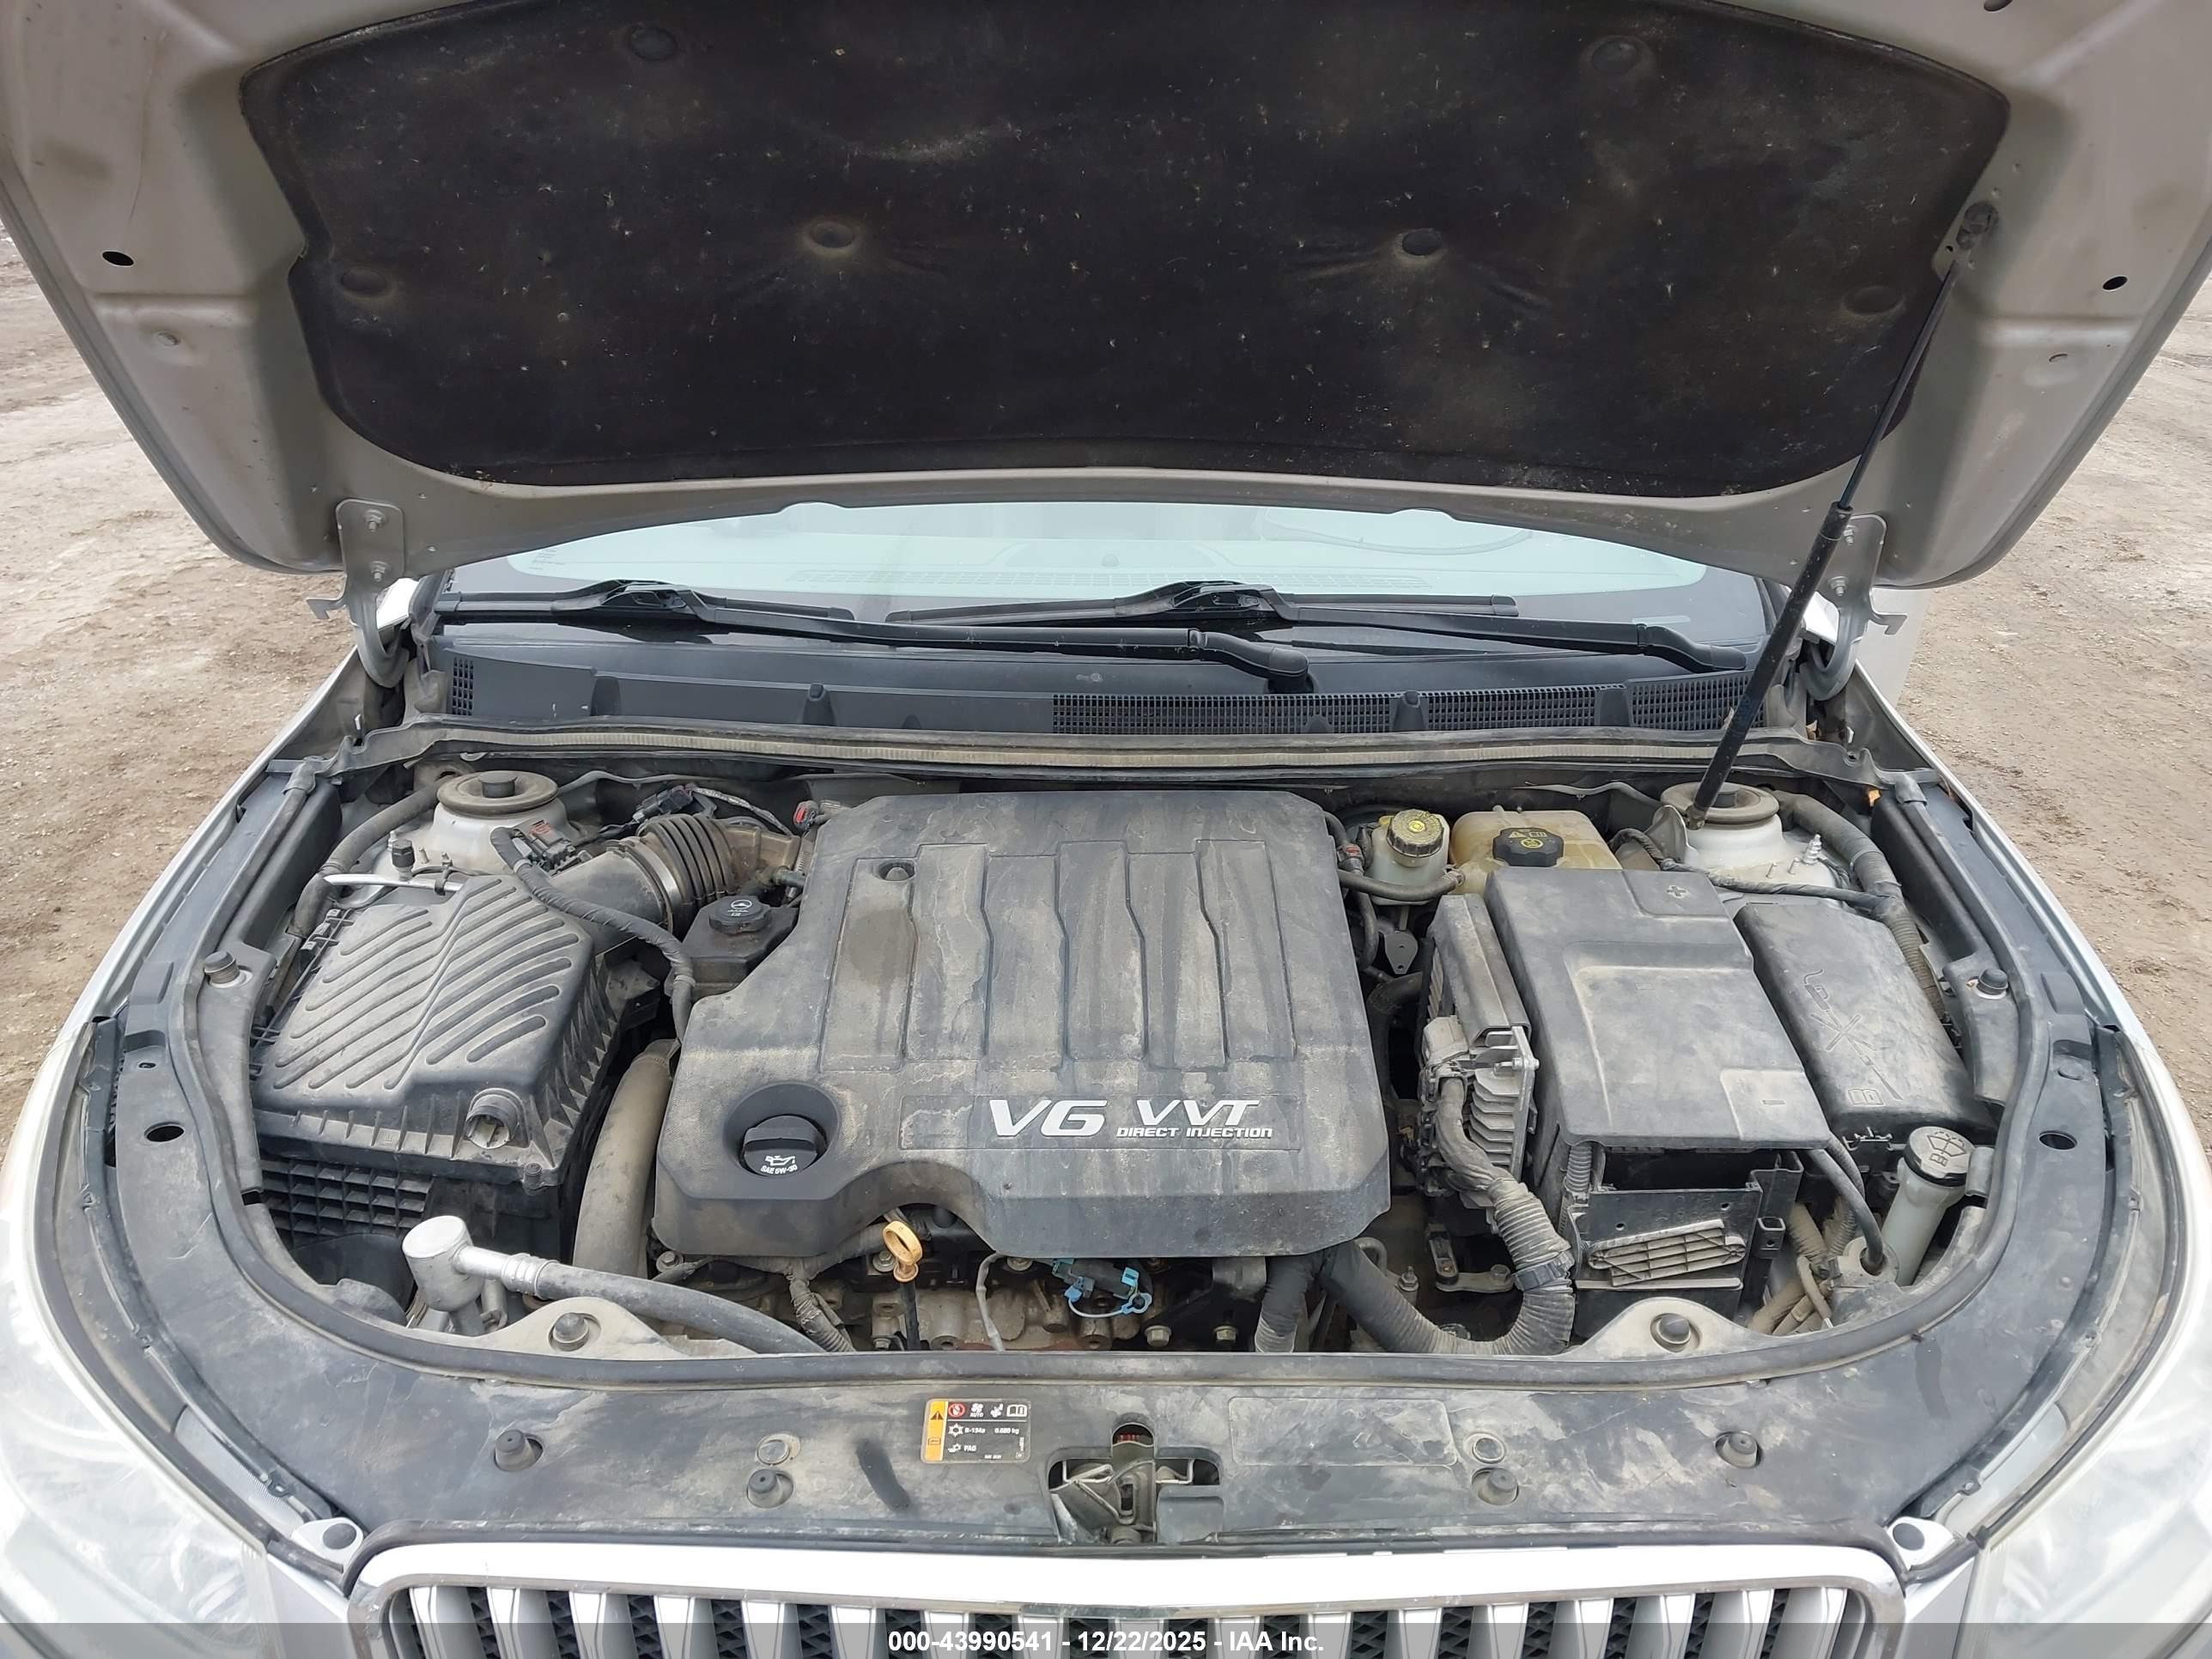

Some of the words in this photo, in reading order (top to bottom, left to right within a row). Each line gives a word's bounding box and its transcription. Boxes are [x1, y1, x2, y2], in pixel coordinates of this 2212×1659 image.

[989, 1099, 1108, 1137] V6
[1136, 1099, 1260, 1126] VVT
[1116, 1127, 1179, 1139] DIRECT
[761, 1165, 775, 1174] SAE
